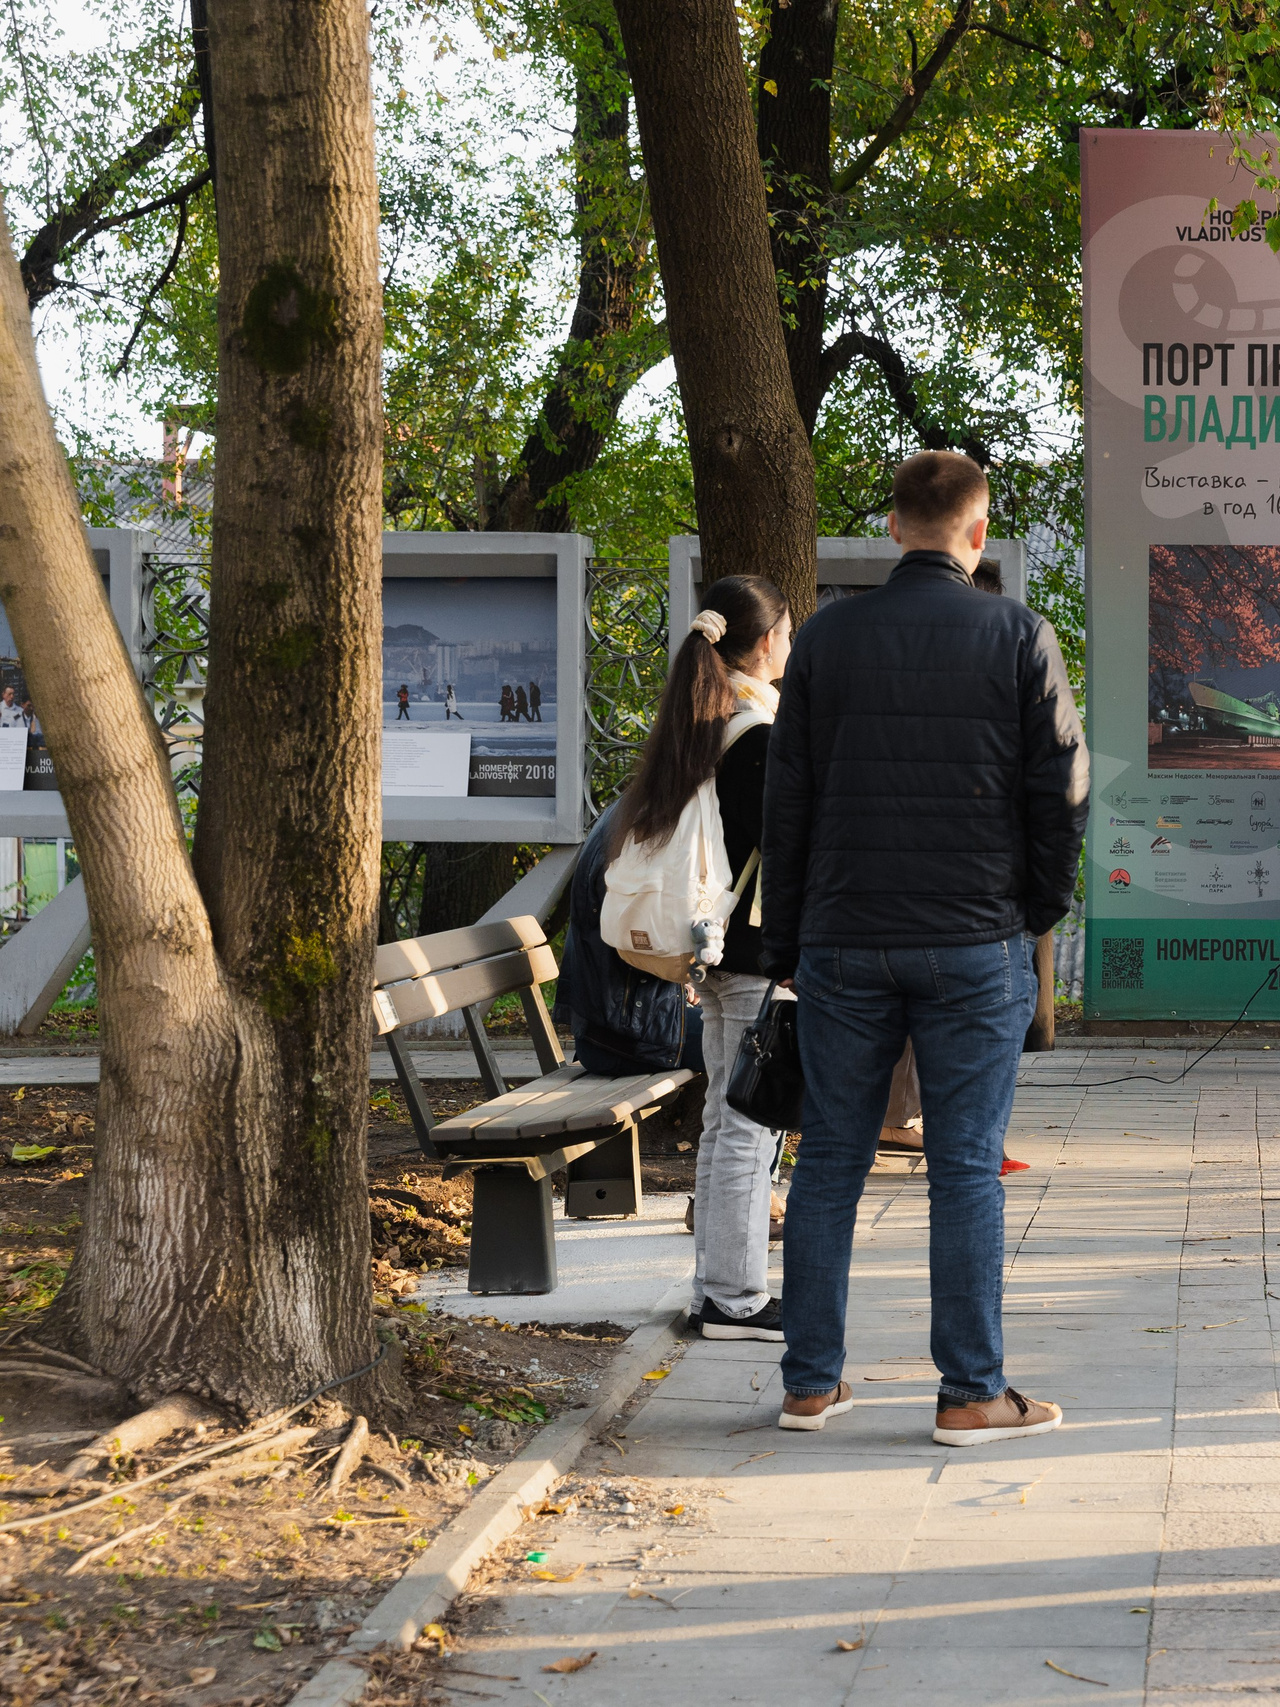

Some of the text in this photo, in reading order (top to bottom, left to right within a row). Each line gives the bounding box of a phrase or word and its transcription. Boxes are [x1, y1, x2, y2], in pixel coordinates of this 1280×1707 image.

[1143, 343, 1234, 386] ПОРТ
[1145, 467, 1246, 488] Выставка
[1203, 502, 1214, 515] в
[1224, 502, 1256, 519] год
[26, 766, 55, 774] VLADIV
[479, 764, 523, 772] HOMEPORT
[525, 764, 555, 780] 2018
[469, 772, 519, 780] LADIVOSTOK
[1101, 979, 1144, 989] ВКОНТАКТЕ
